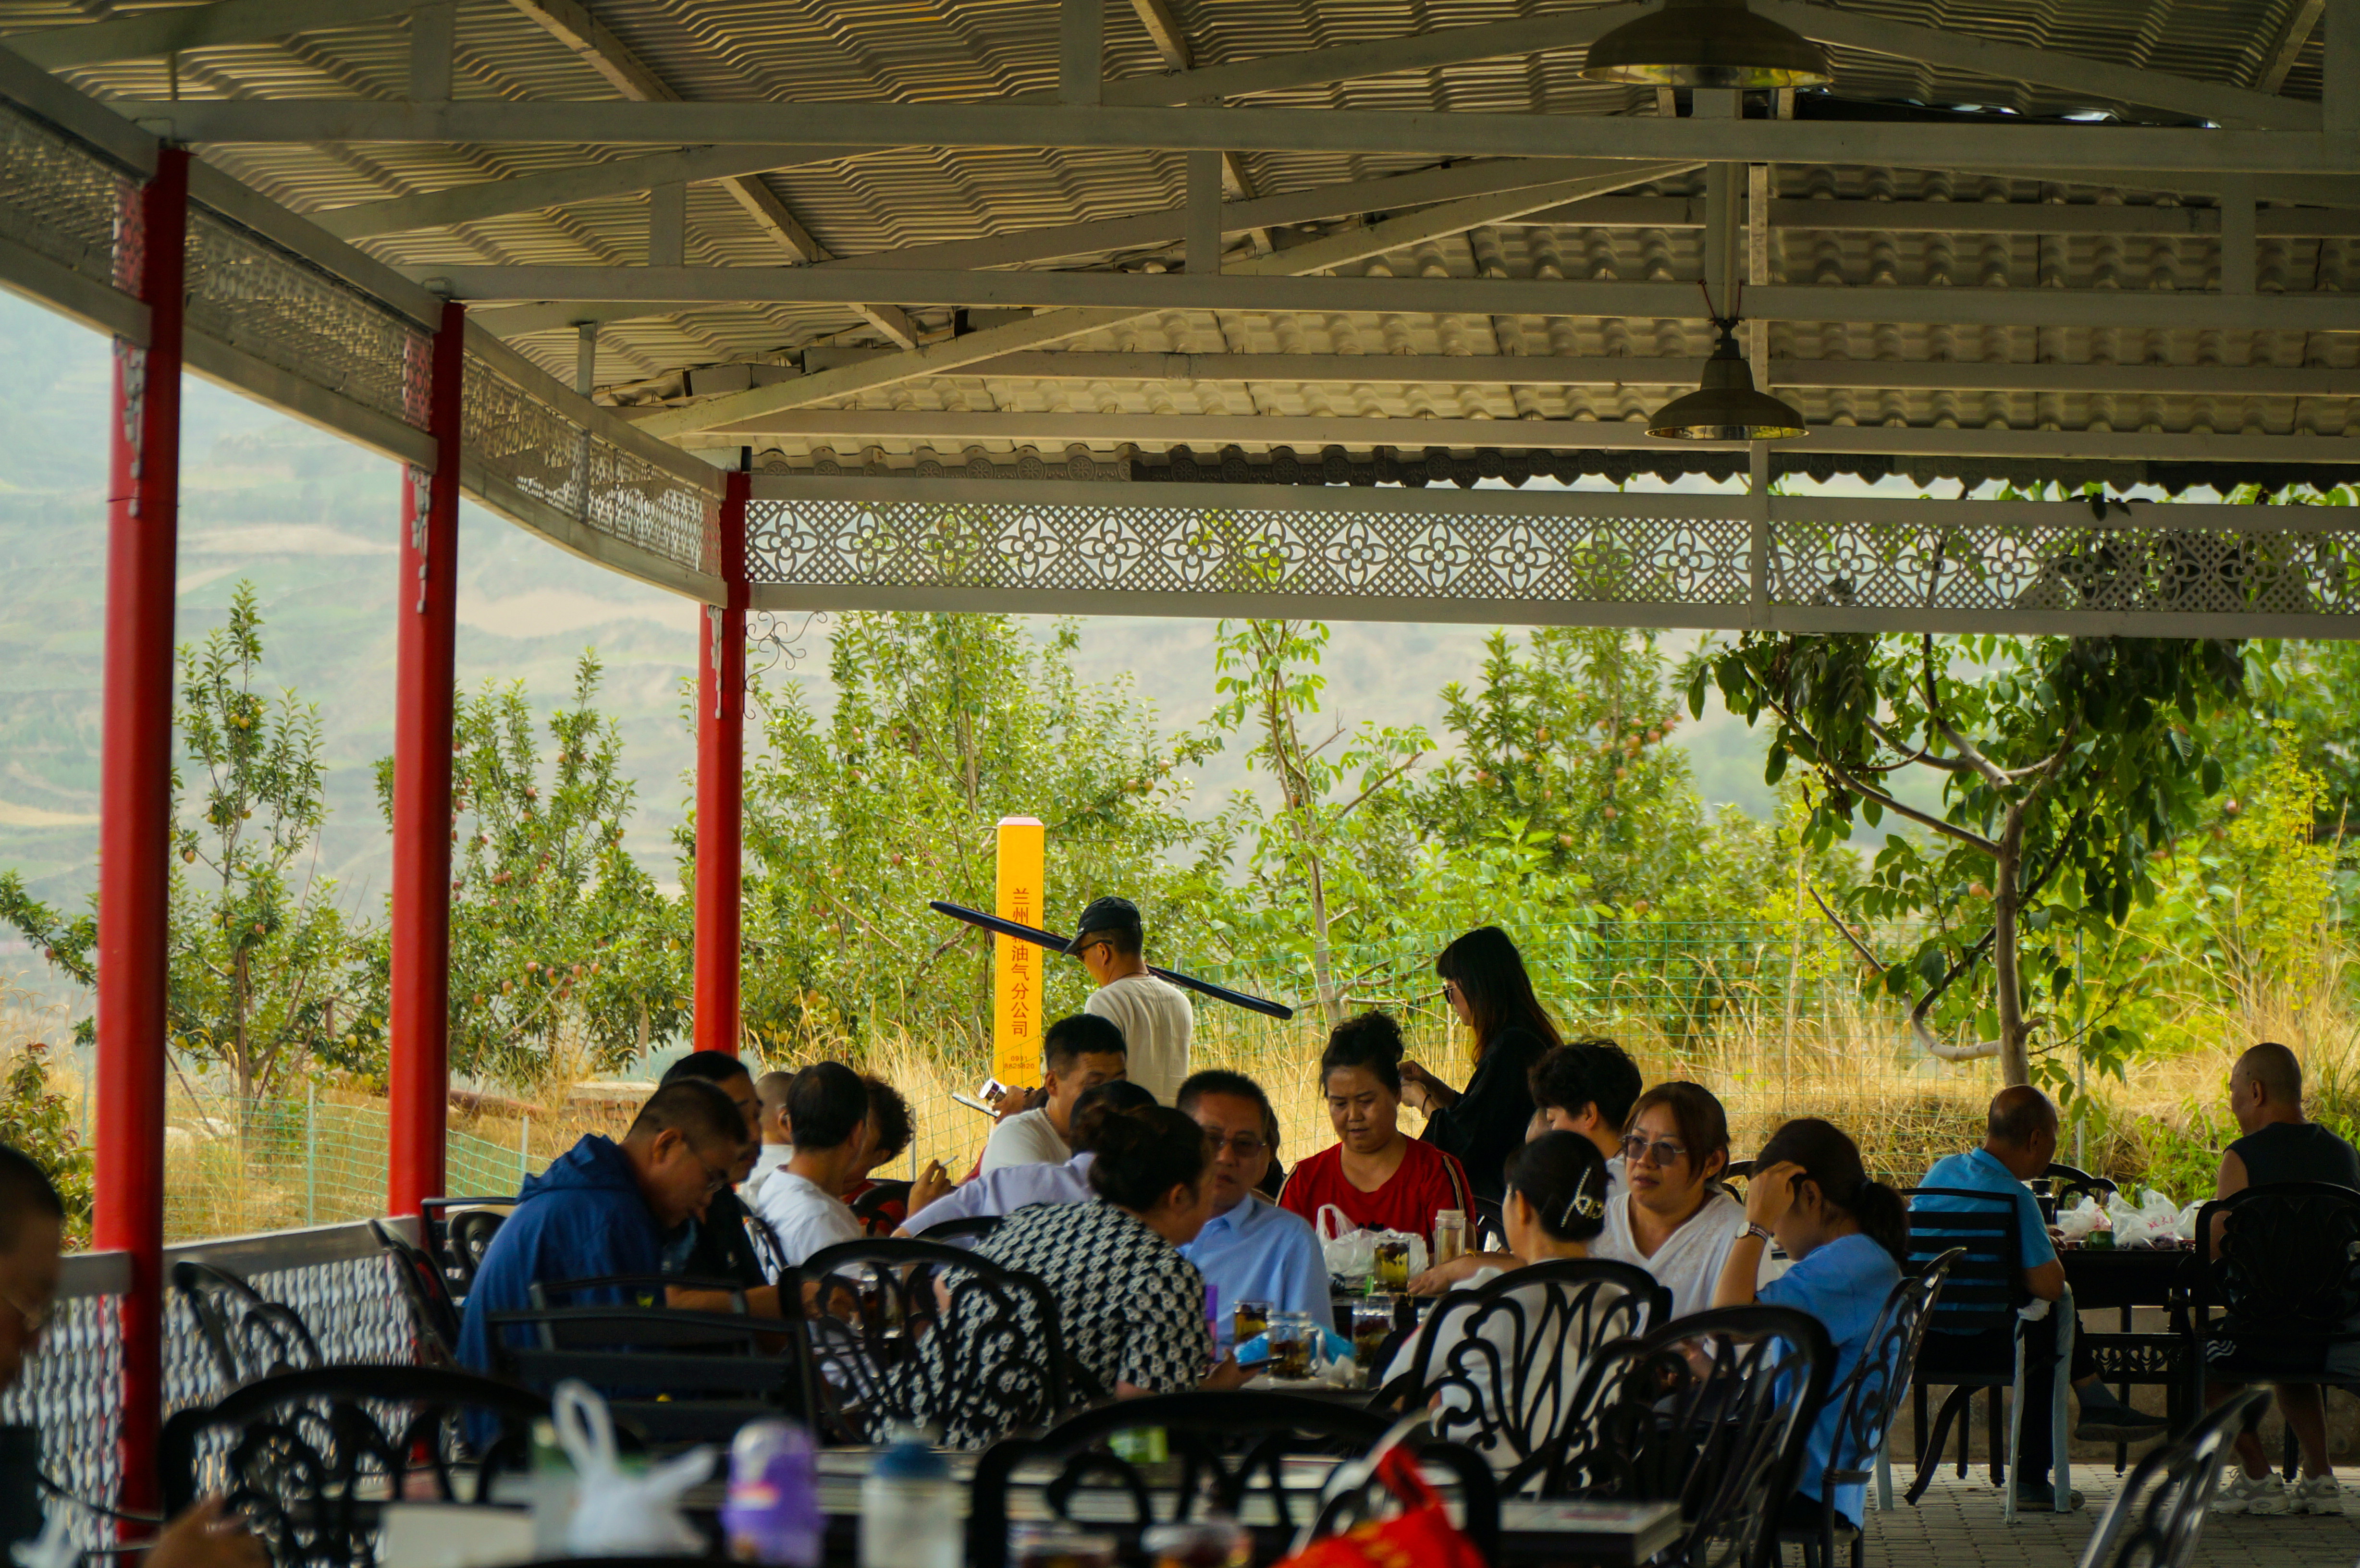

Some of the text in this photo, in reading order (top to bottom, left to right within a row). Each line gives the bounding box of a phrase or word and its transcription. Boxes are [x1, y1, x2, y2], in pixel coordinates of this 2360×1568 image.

[1011, 888, 1030, 1037] 兰州油气分公司
